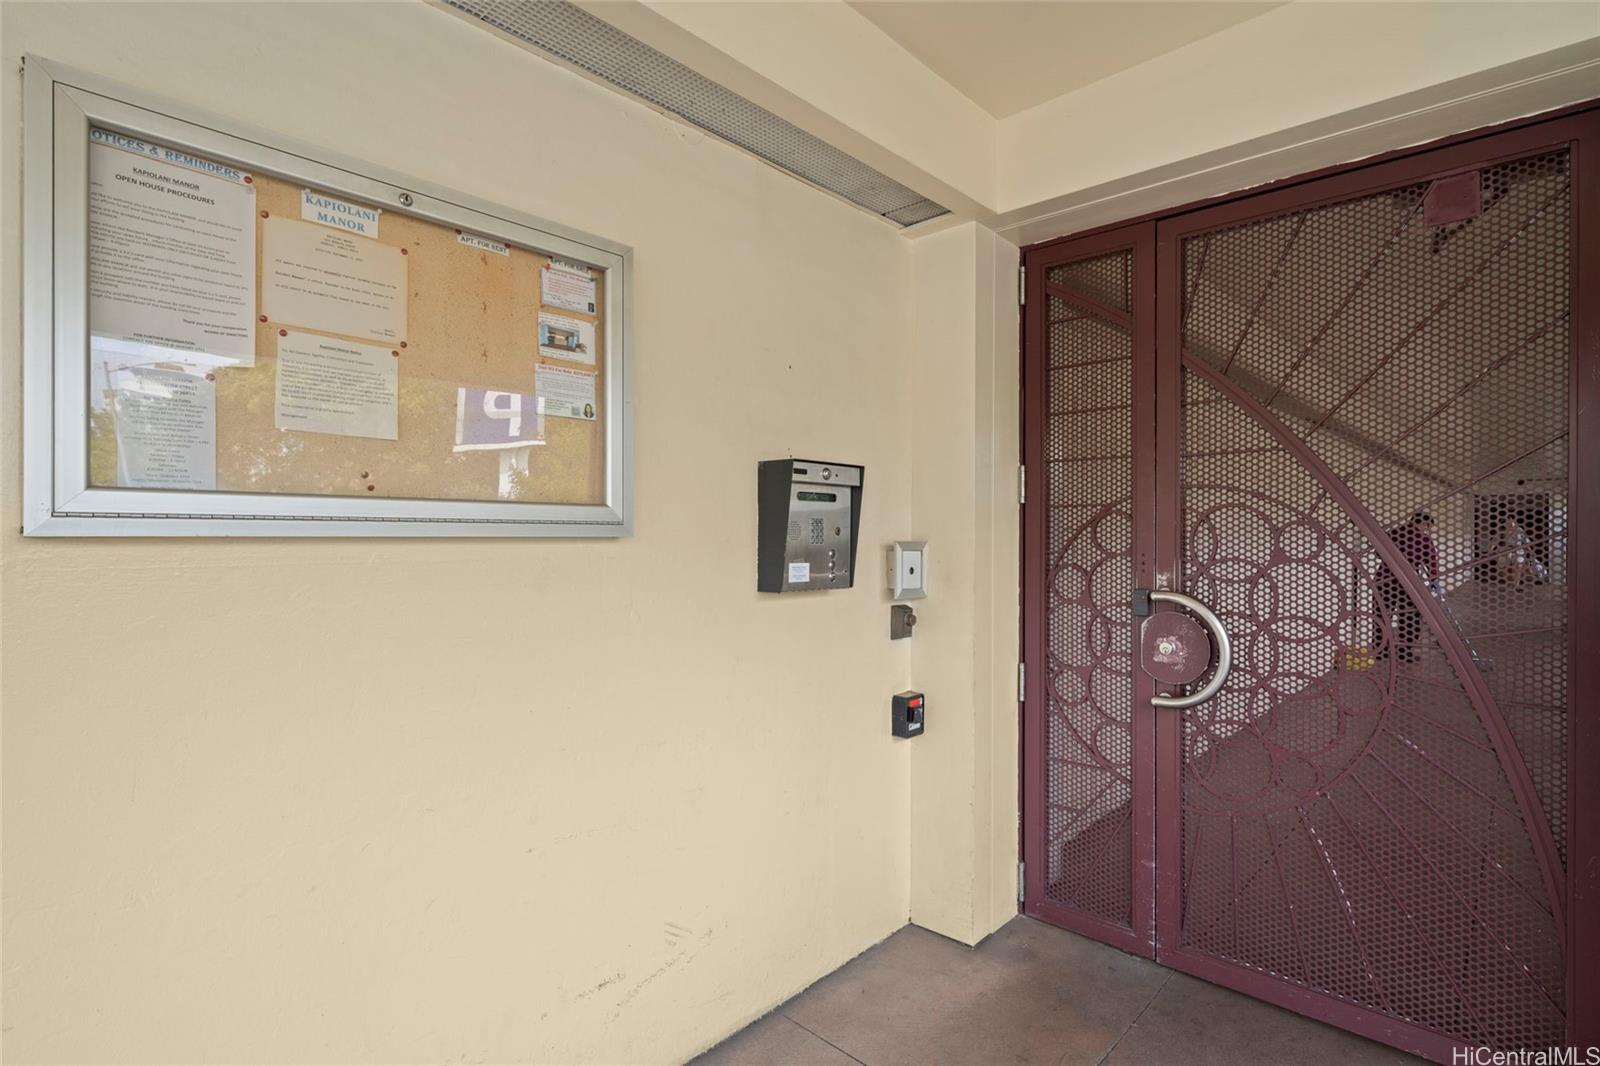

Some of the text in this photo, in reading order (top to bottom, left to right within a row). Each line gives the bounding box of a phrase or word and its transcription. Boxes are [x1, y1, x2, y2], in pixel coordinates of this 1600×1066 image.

[91, 129, 241, 181] OTICES & REMINDERS
[115, 173, 137, 186] OPEN
[139, 180, 165, 193] HOUSE
[166, 187, 216, 205] PROCEDURES
[132, 166, 200, 190] KAPIOLANI MANOR
[305, 195, 376, 222] KAPIOLANI
[317, 211, 365, 232] MANOR
[478, 240, 490, 249] FOR
